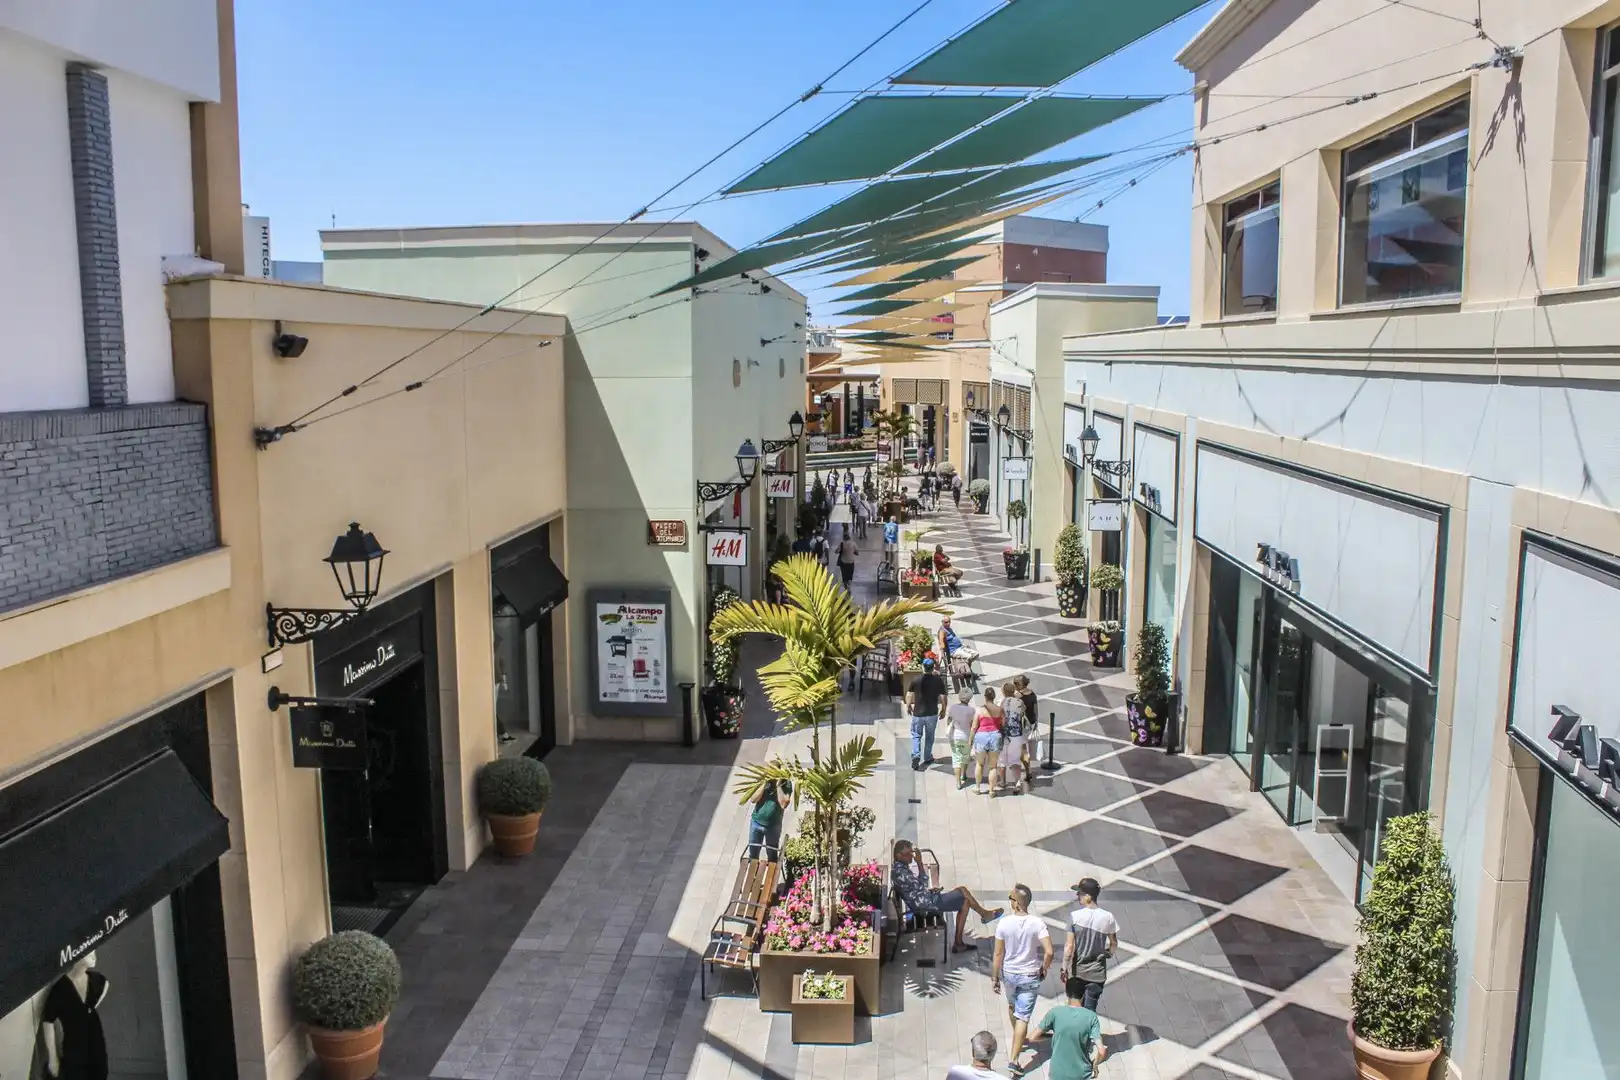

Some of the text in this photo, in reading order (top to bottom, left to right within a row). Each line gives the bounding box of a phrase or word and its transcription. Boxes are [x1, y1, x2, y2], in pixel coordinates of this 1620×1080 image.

[261, 226, 269, 278] HITECS
[770, 480, 790, 493] H&M
[712, 539, 742, 558] H&M
[617, 605, 663, 615] Alcampo
[343, 643, 396, 687] Massimo Dutti
[60, 908, 129, 967] Massimo Dutti
